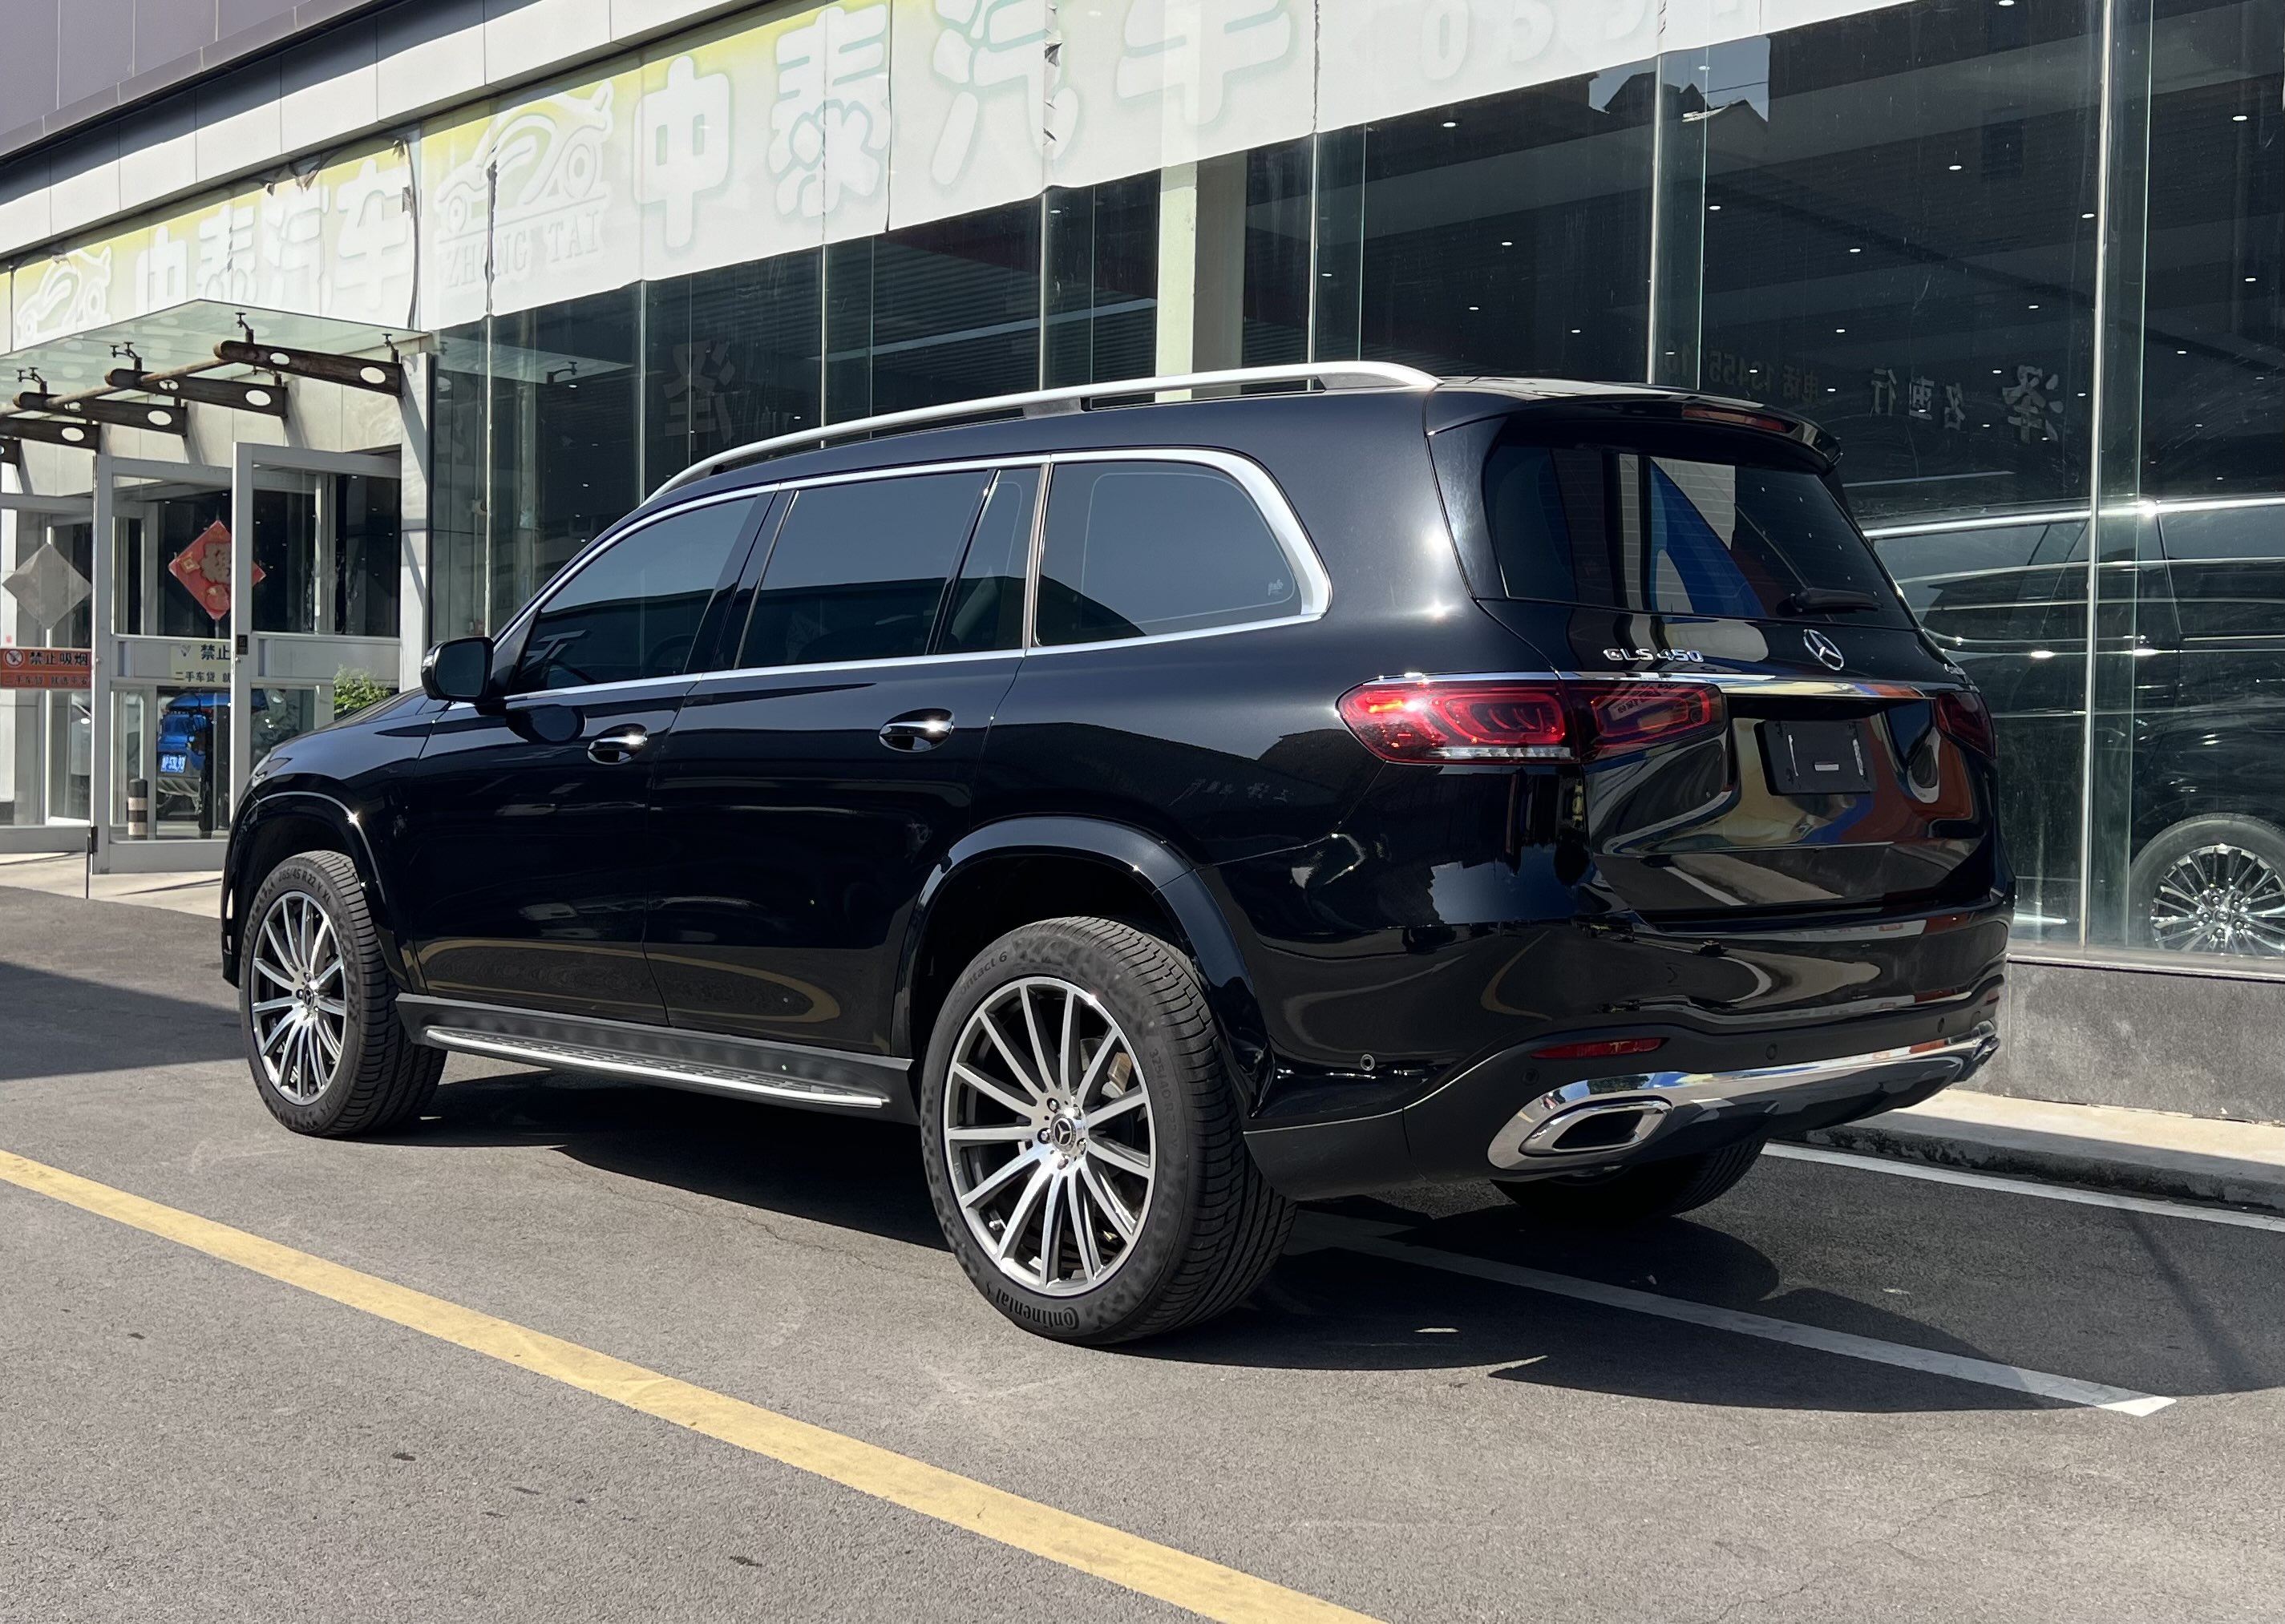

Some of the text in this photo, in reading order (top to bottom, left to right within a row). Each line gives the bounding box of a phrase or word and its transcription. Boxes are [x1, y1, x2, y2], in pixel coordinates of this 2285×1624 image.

[30, 652, 88, 666] 禁止吸烟
[200, 643, 232, 661] 禁止
[1603, 648, 1705, 663] GLS 450
[999, 951, 1008, 963] 6
[996, 1288, 1080, 1331] Continental
